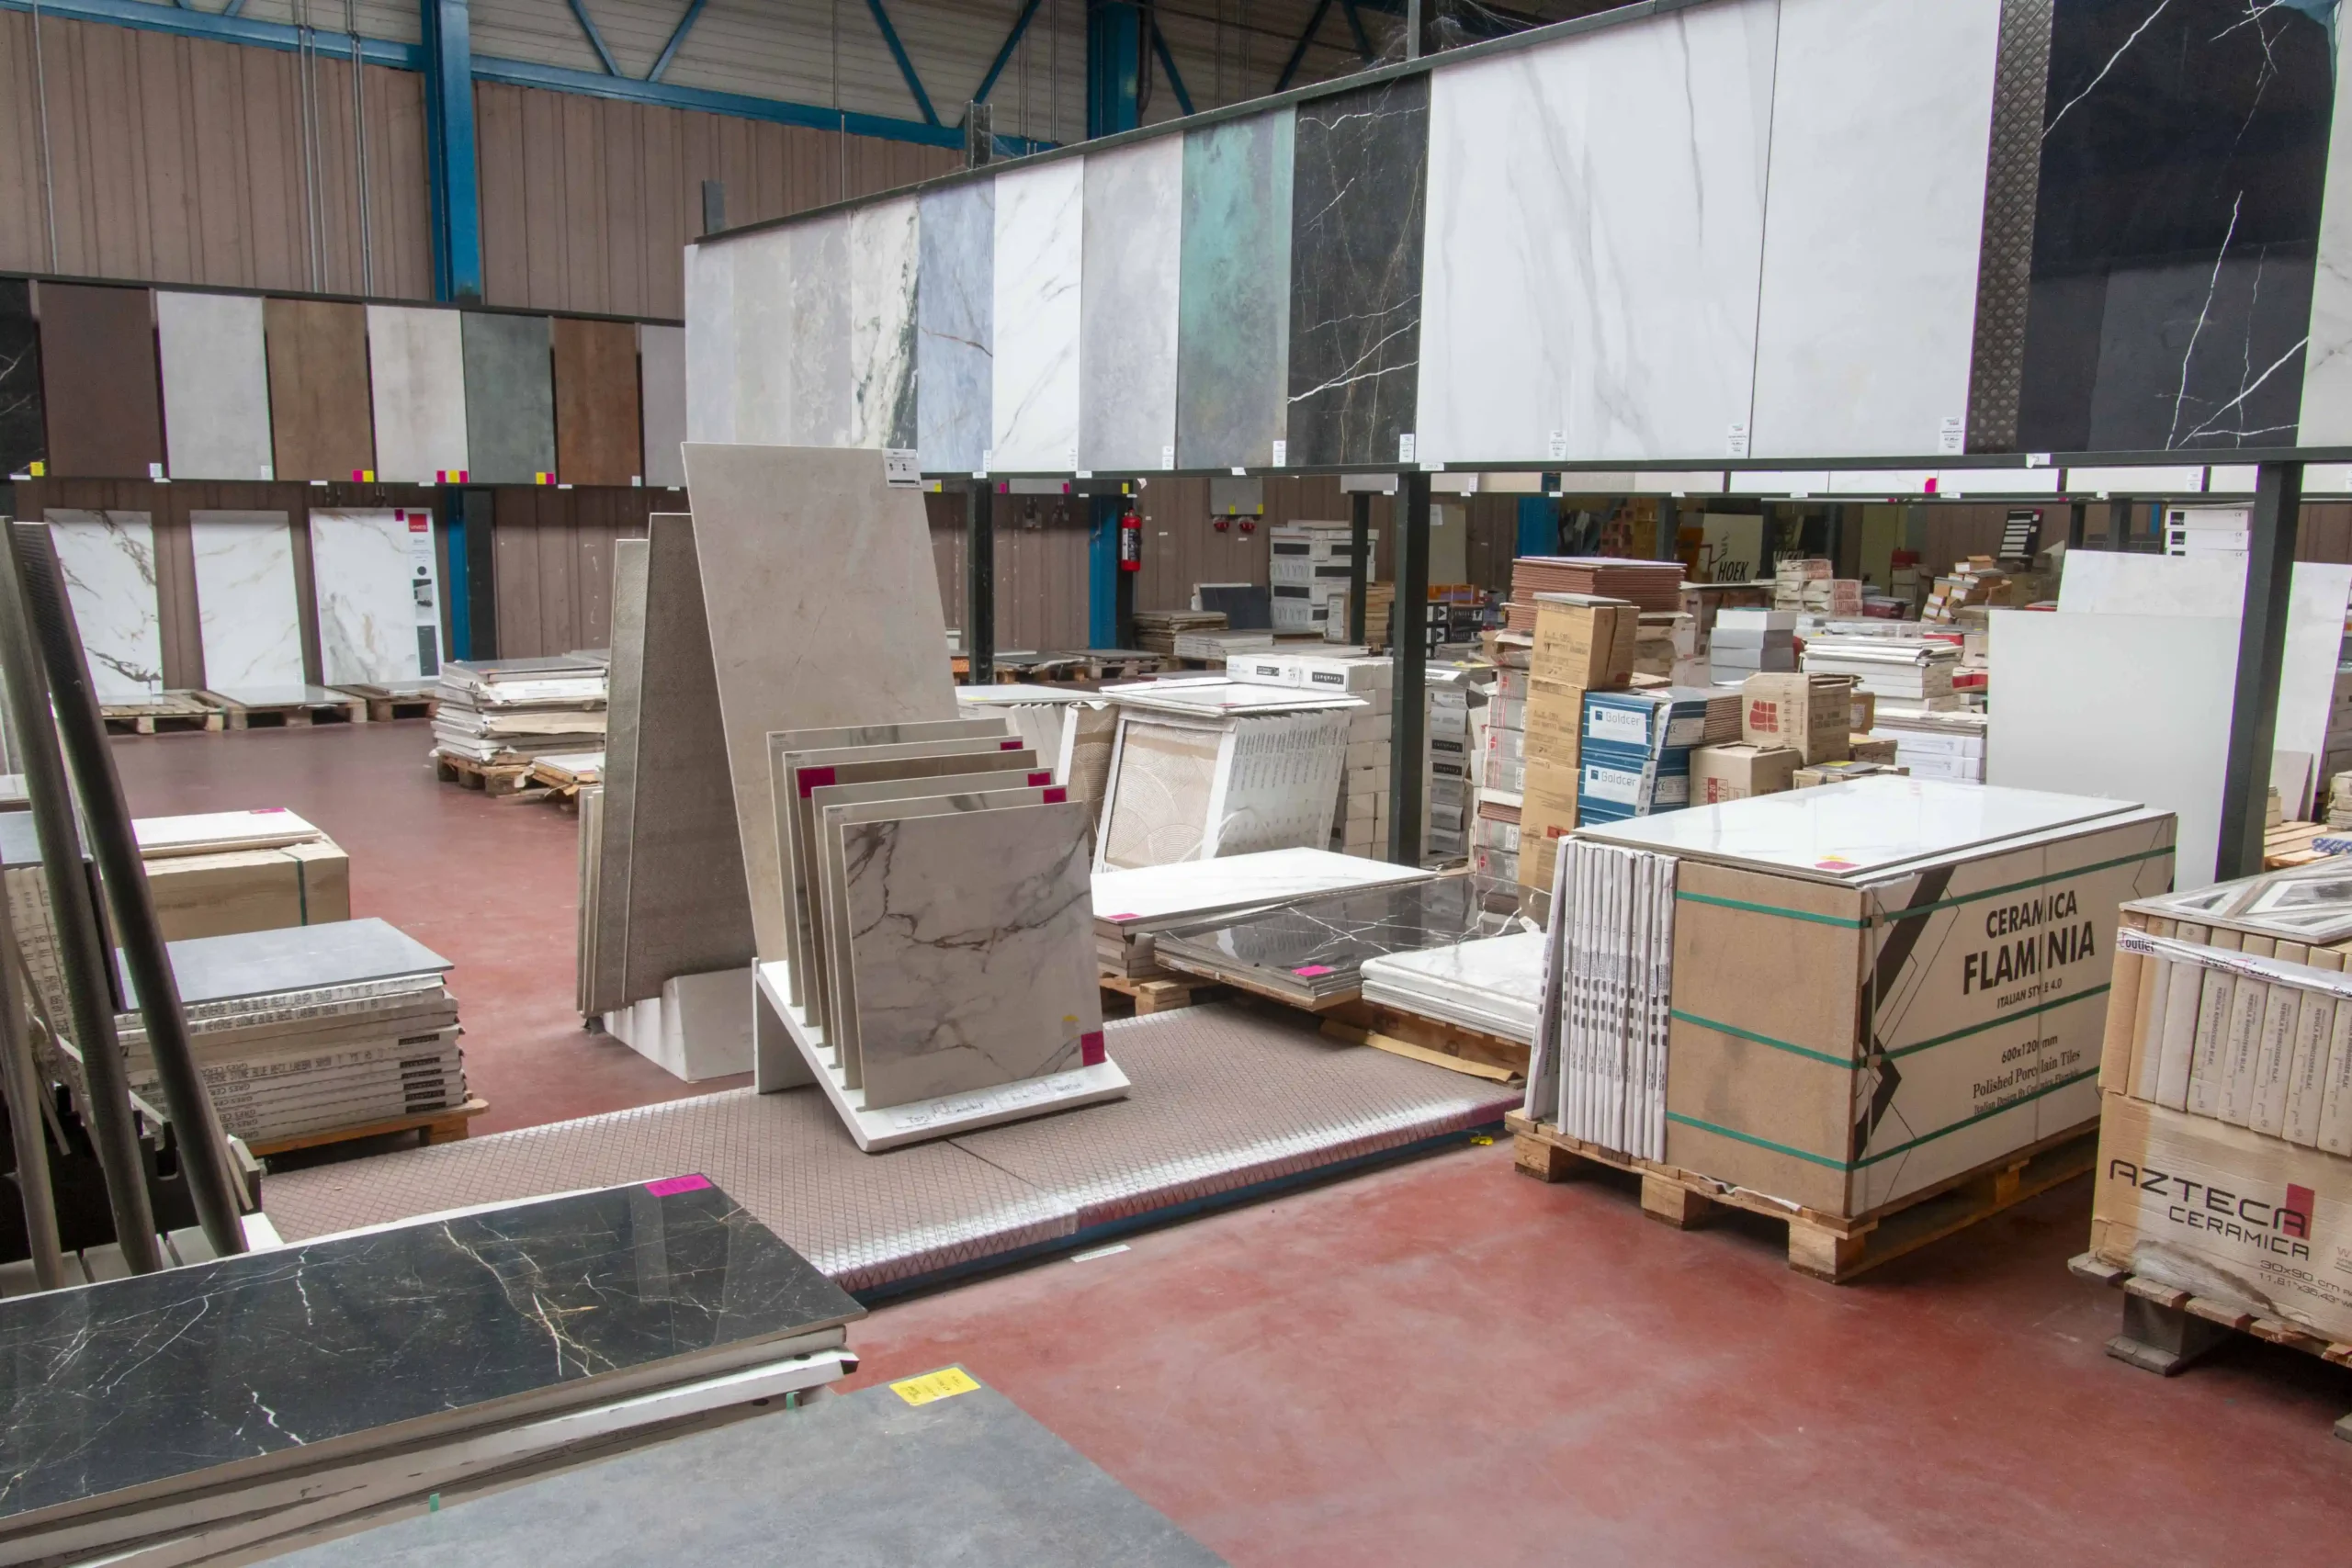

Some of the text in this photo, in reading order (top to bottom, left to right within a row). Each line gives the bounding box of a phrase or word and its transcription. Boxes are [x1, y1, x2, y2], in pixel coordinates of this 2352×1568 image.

[1986, 890, 2078, 939] CERAMICA
[1963, 920, 2096, 995] FLAMINIA
[1996, 989, 2027, 1010] ITALIAN
[2051, 978, 2063, 989] 4.0
[1973, 1069, 2014, 1099] Polished
[2060, 1048, 2081, 1066] Tiles
[2109, 1159, 2307, 1237] AZTECA
[2169, 1205, 2310, 1261] CERAMICA
[2260, 1259, 2313, 1281] 30x90
[2317, 1279, 2340, 1292] cm
